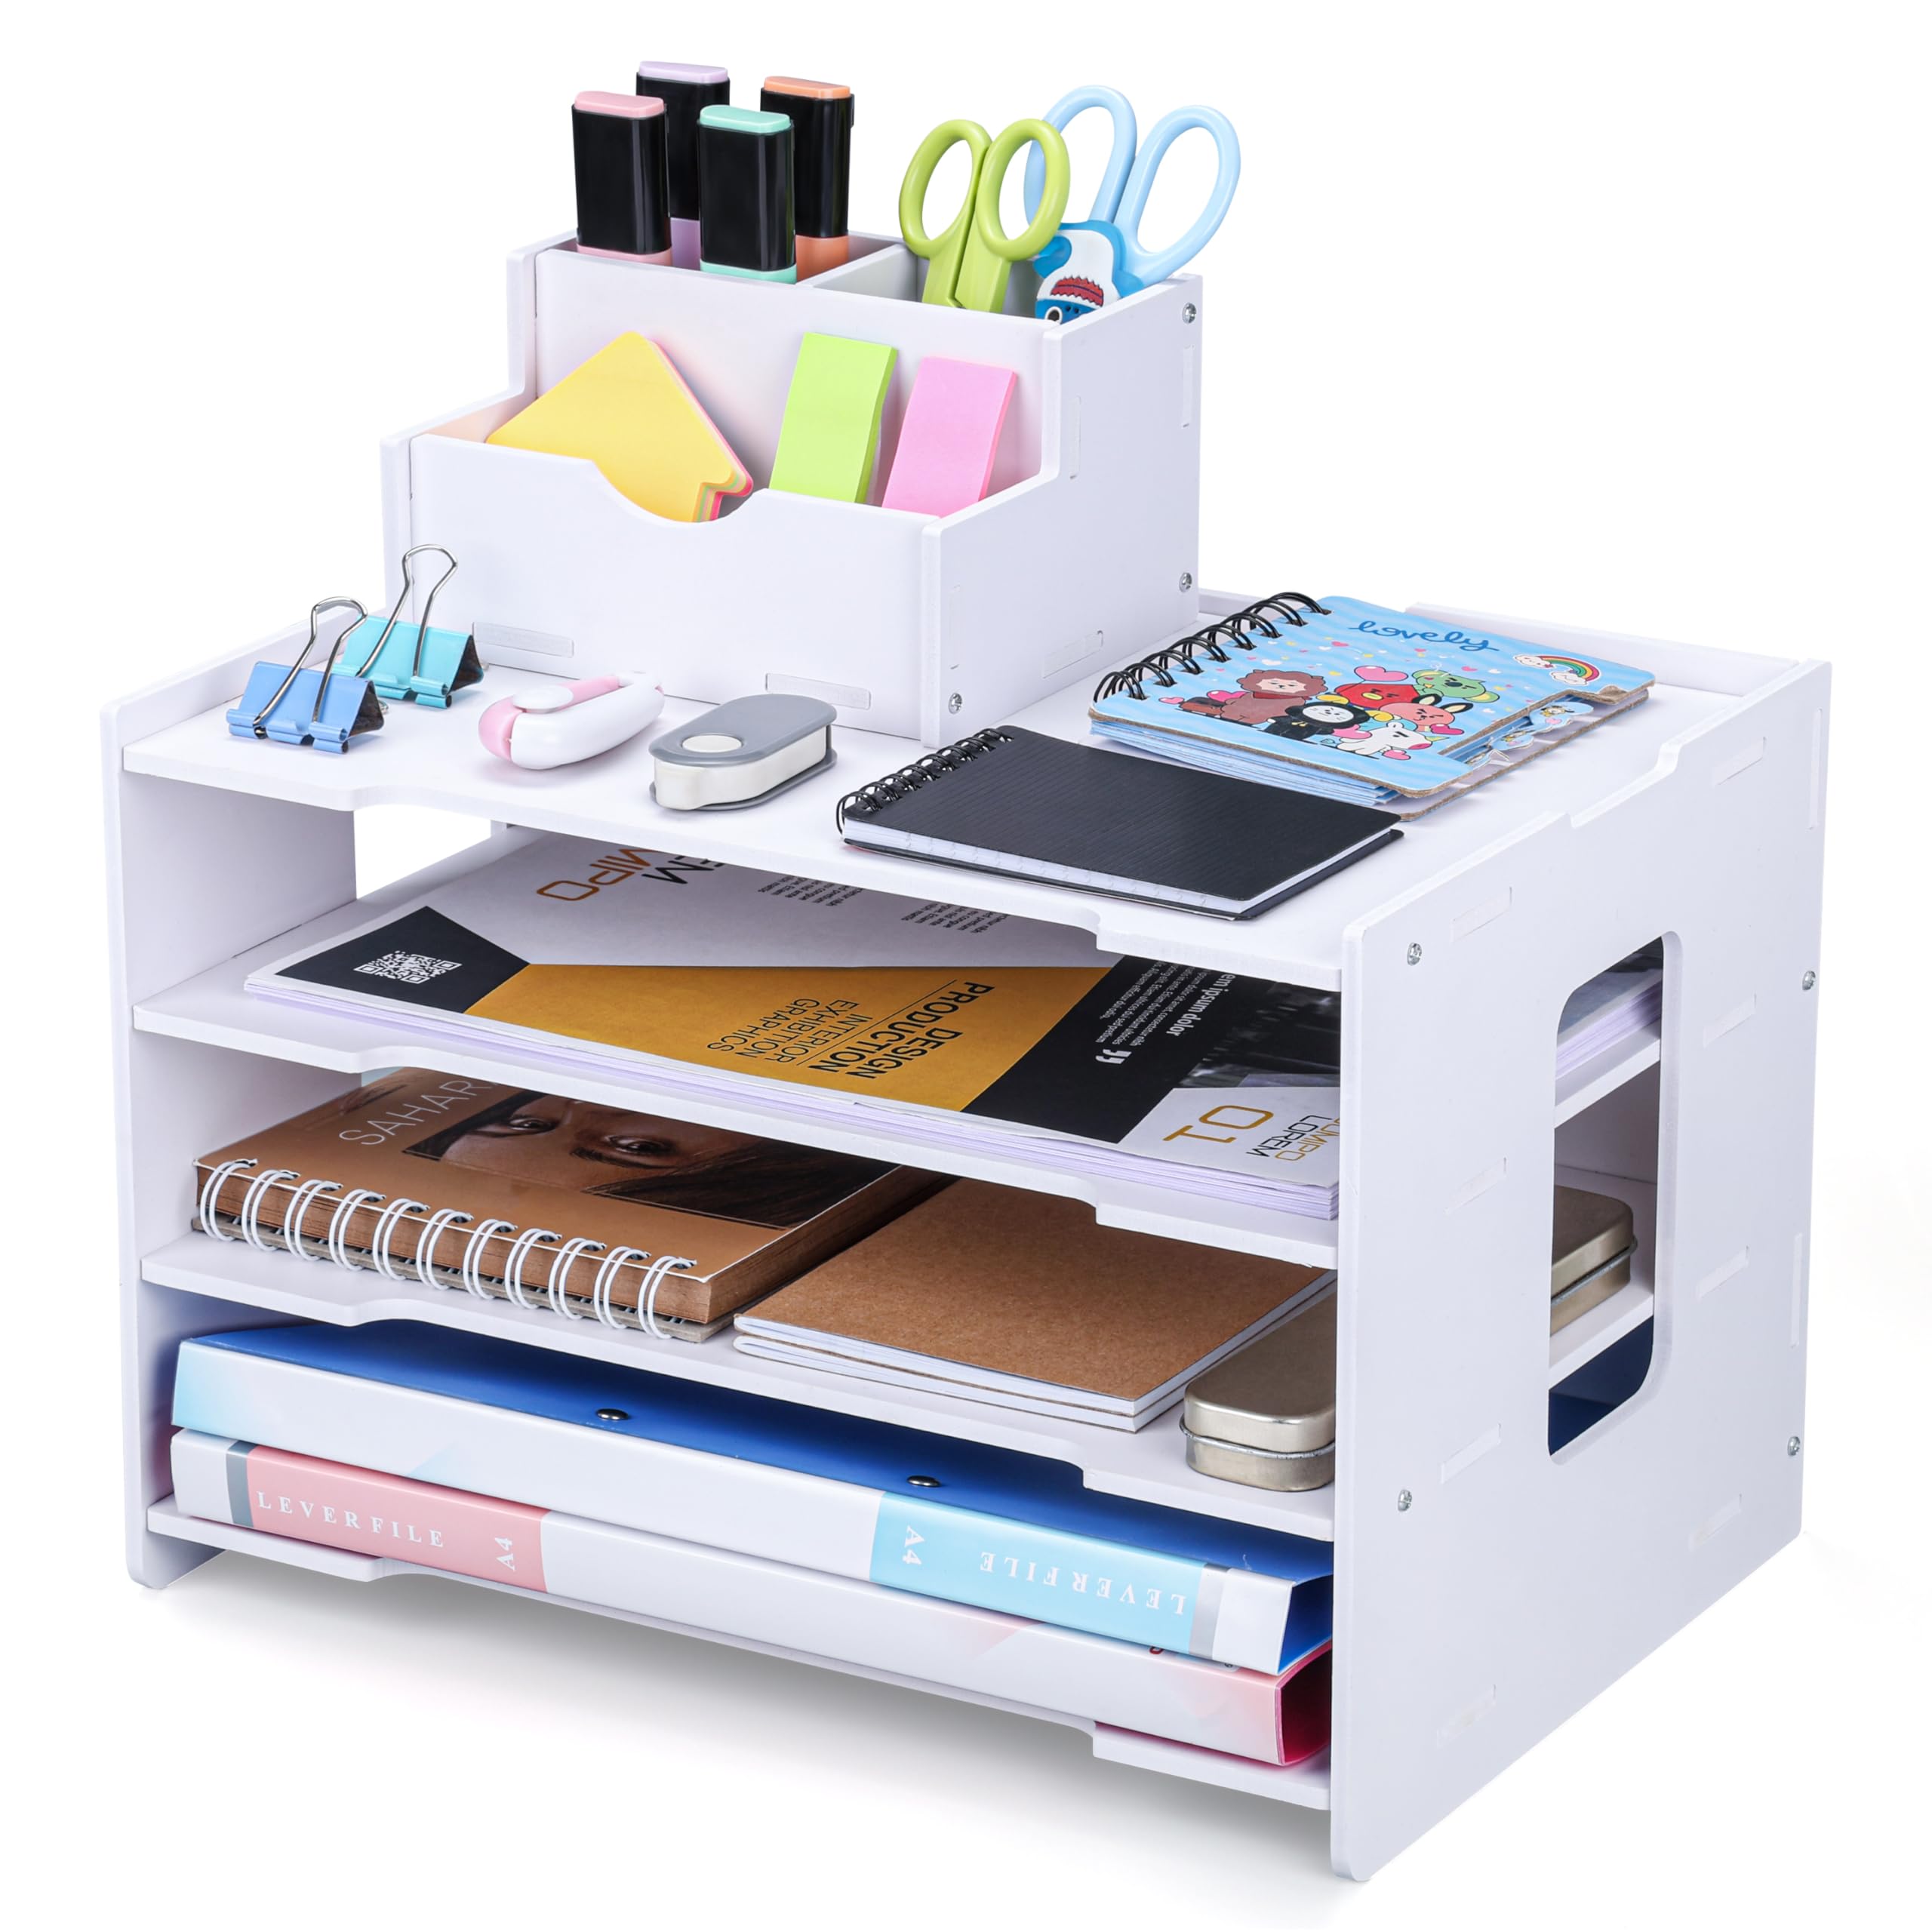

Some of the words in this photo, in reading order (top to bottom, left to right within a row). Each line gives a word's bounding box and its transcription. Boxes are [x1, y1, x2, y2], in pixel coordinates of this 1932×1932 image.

[1348, 620, 1500, 651] lovely
[1188, 987, 1229, 1013] ipsum
[1214, 974, 1236, 989] em
[707, 998, 820, 1051] GRAPHICS
[735, 999, 859, 1058] EXHIBITION
[765, 1014, 872, 1063] INTERIOR
[808, 981, 995, 1072] PRODUCTION
[1166, 1013, 1201, 1036] dolor
[845, 1028, 963, 1079] DESIGN
[339, 1080, 498, 1145] SAHAR
[1163, 1105, 1274, 1143] 01
[1246, 1115, 1332, 1157] LOREM
[1275, 1118, 1340, 1161] UMIPO
[256, 1491, 445, 1548] LEVERFILE
[495, 1537, 515, 1571] A4
[903, 1525, 924, 1565] A4
[980, 1551, 1186, 1616] LEVERFILE
